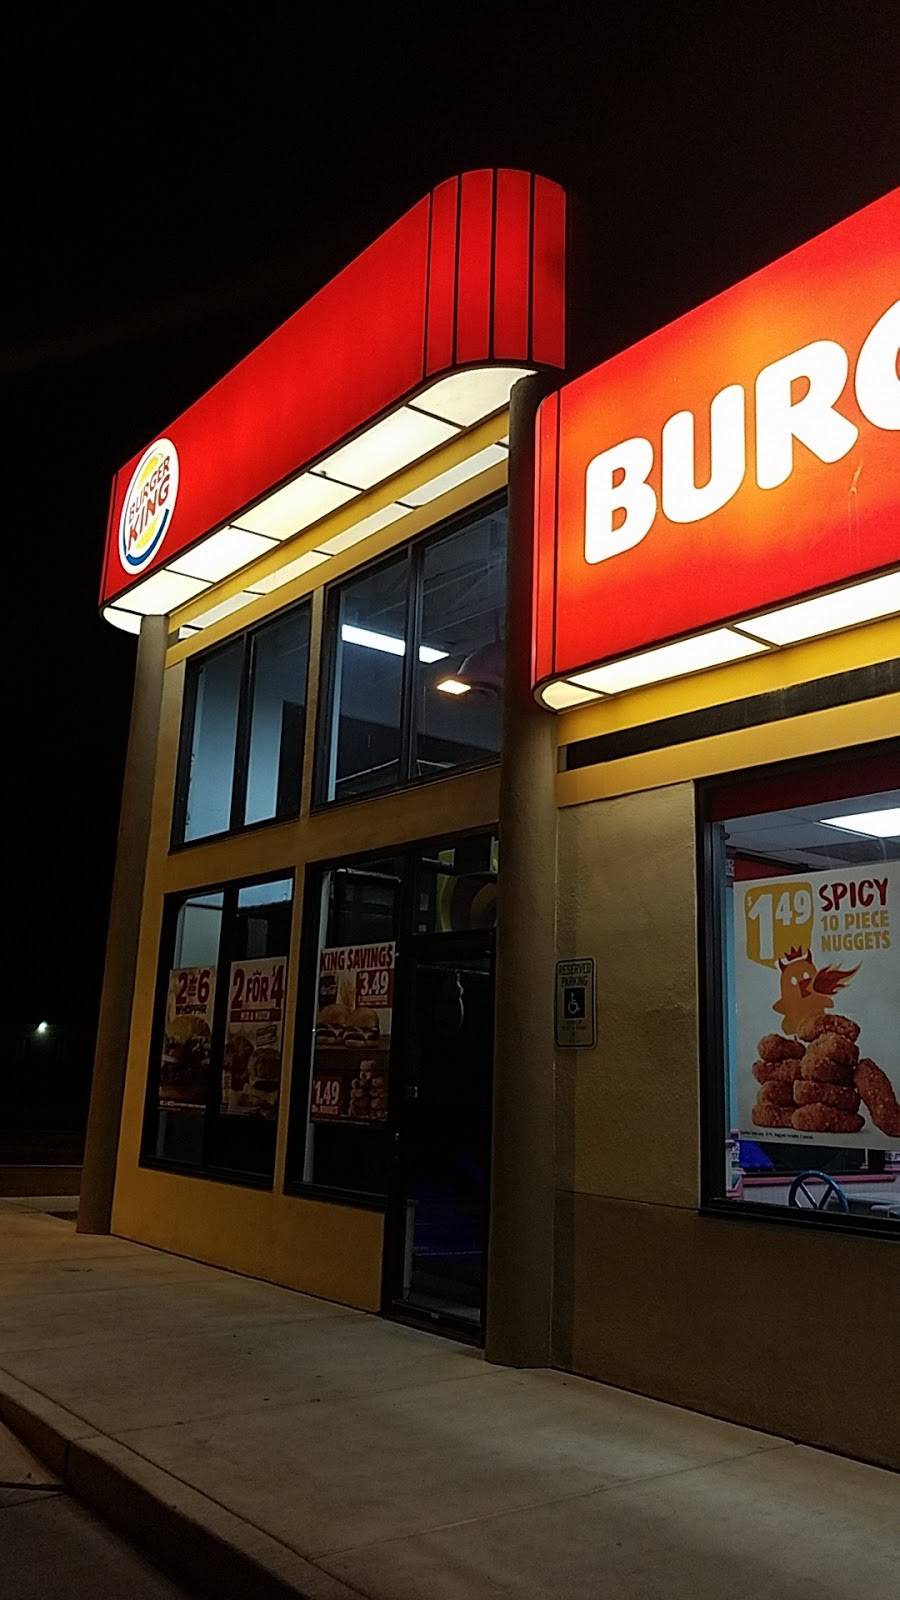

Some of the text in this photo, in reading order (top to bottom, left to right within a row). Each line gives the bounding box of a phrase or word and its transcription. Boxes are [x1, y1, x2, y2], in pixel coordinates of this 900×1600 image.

[129, 455, 170, 523] BURGER
[127, 474, 170, 551] KING
[818, 878, 888, 911] SPICY
[821, 910, 889, 931] 10 PIECE
[821, 930, 892, 952] NUGGETS
[320, 950, 344, 971] KING
[175, 972, 188, 1004] 2
[231, 968, 245, 1009] 2
[245, 976, 268, 1003] FOR
